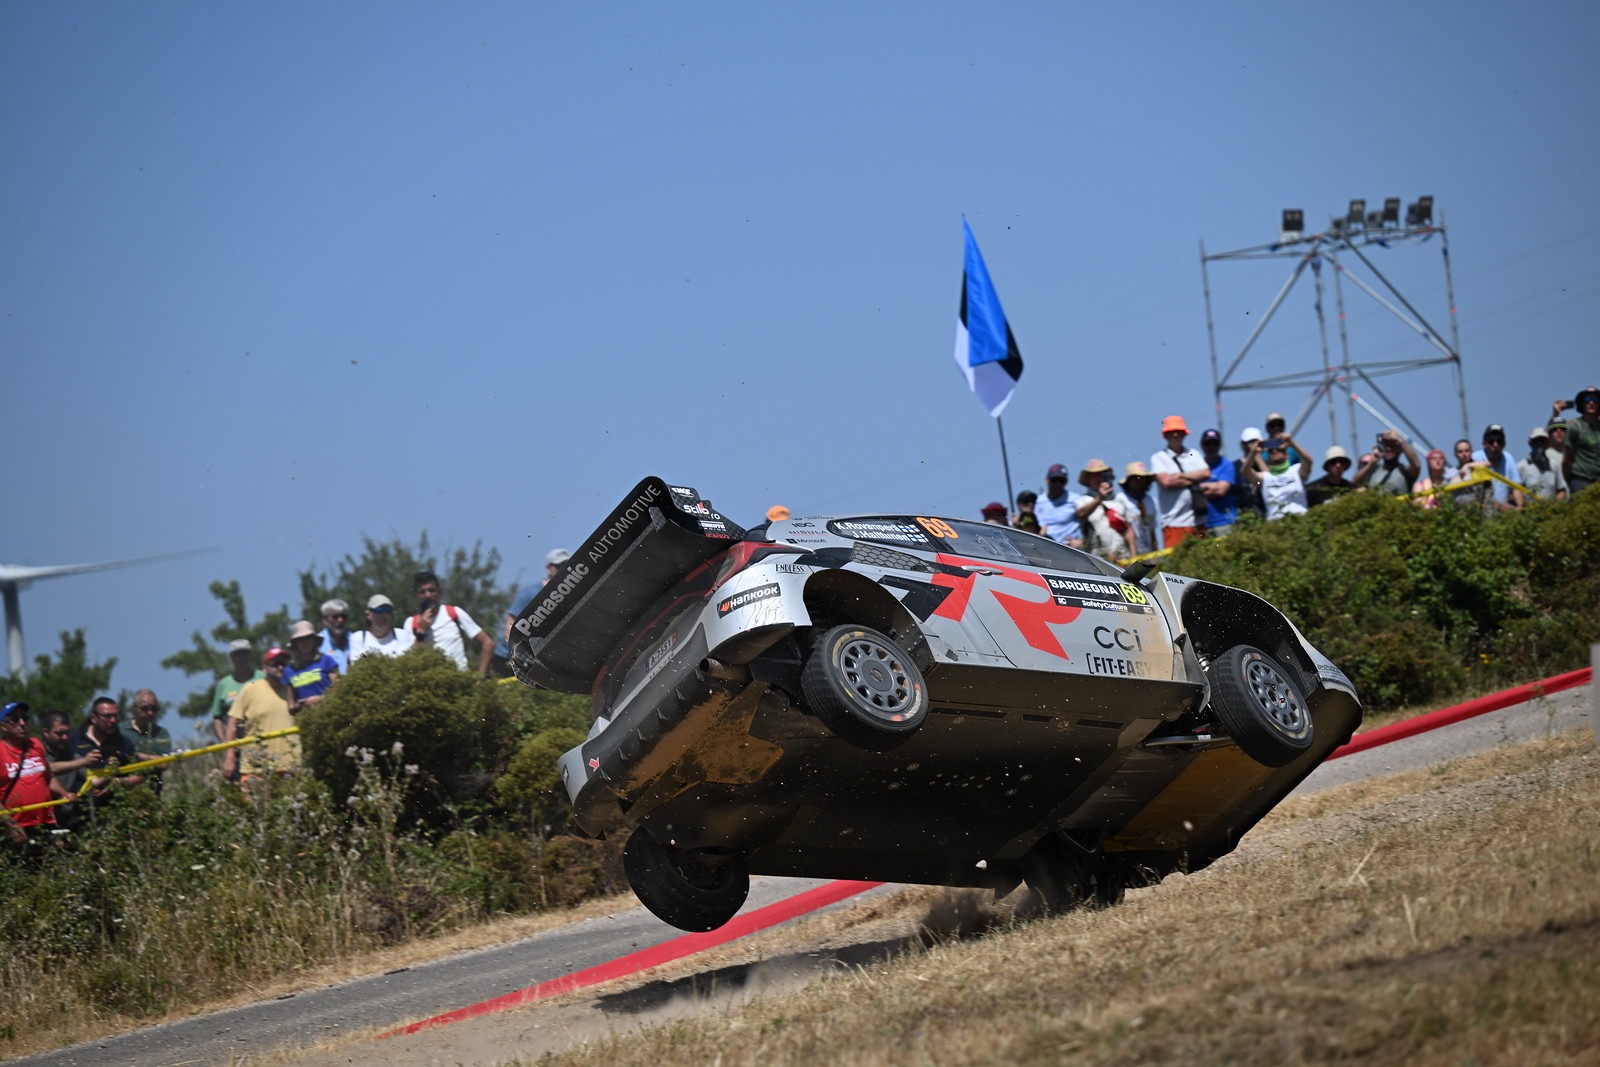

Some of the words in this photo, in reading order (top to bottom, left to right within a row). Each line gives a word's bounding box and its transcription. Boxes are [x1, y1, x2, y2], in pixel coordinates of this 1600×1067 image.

[683, 501, 710, 515] Stilo
[915, 516, 959, 539] 69
[514, 563, 590, 637] Panasonic
[588, 484, 662, 563] AUTOMOTIVE
[775, 563, 805, 572] ENDLESS
[1165, 577, 1185, 585] PIAA
[1048, 579, 1119, 596] SARDEGNA
[1120, 583, 1147, 605] 69
[1081, 599, 1128, 612] SafetyCulture
